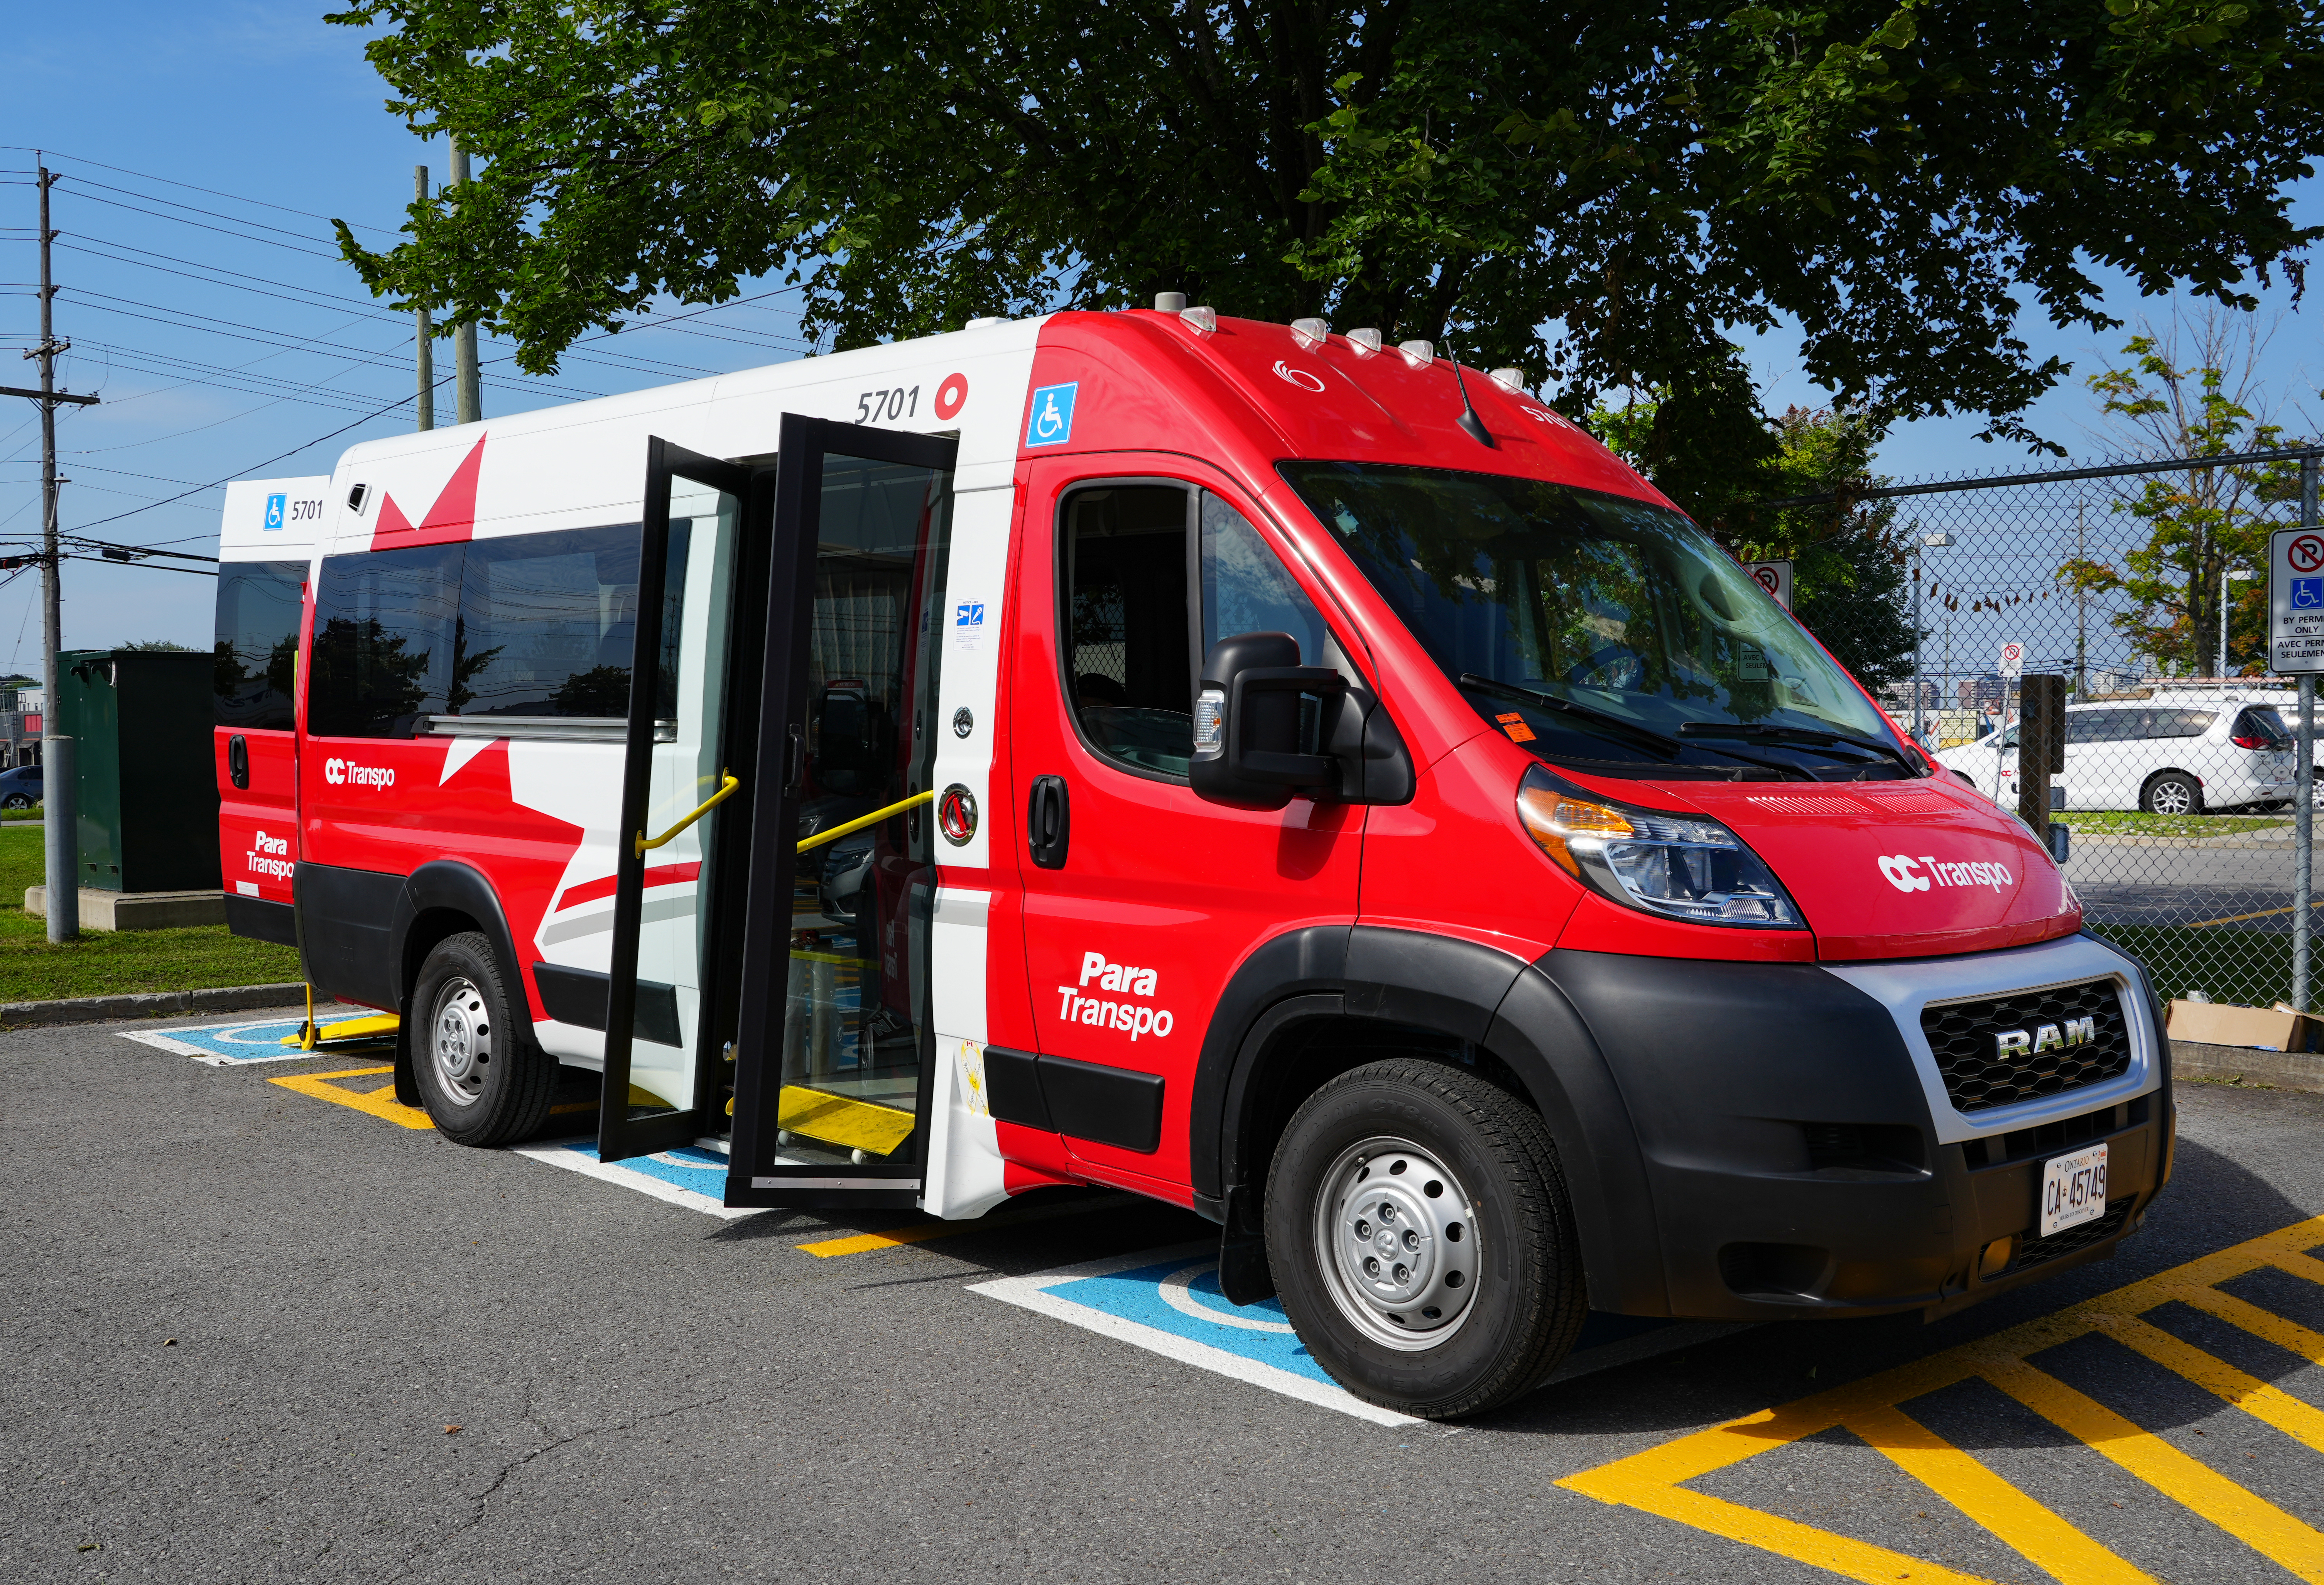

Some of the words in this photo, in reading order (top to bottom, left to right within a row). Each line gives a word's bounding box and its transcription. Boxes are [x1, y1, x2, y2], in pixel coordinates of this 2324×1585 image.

[855, 385, 920, 425] 5701
[1519, 405, 1578, 433] 5701
[292, 500, 323, 520] 5701
[325, 758, 345, 784] OC
[346, 761, 395, 791] Transpo
[255, 830, 288, 855] Para
[247, 851, 294, 881] Transpo
[1878, 854, 1930, 893] OC
[1918, 856, 2013, 893] Transpo
[1079, 951, 1157, 997] Para
[1058, 986, 1173, 1042] Transpo
[1995, 1016, 2095, 1061] RAM
[2065, 1155, 2089, 1172] ONTARIO
[2047, 1178, 2061, 1216] CA
[2069, 1164, 2105, 1208] 45749
[2074, 1206, 2089, 1216] DISCOVER
